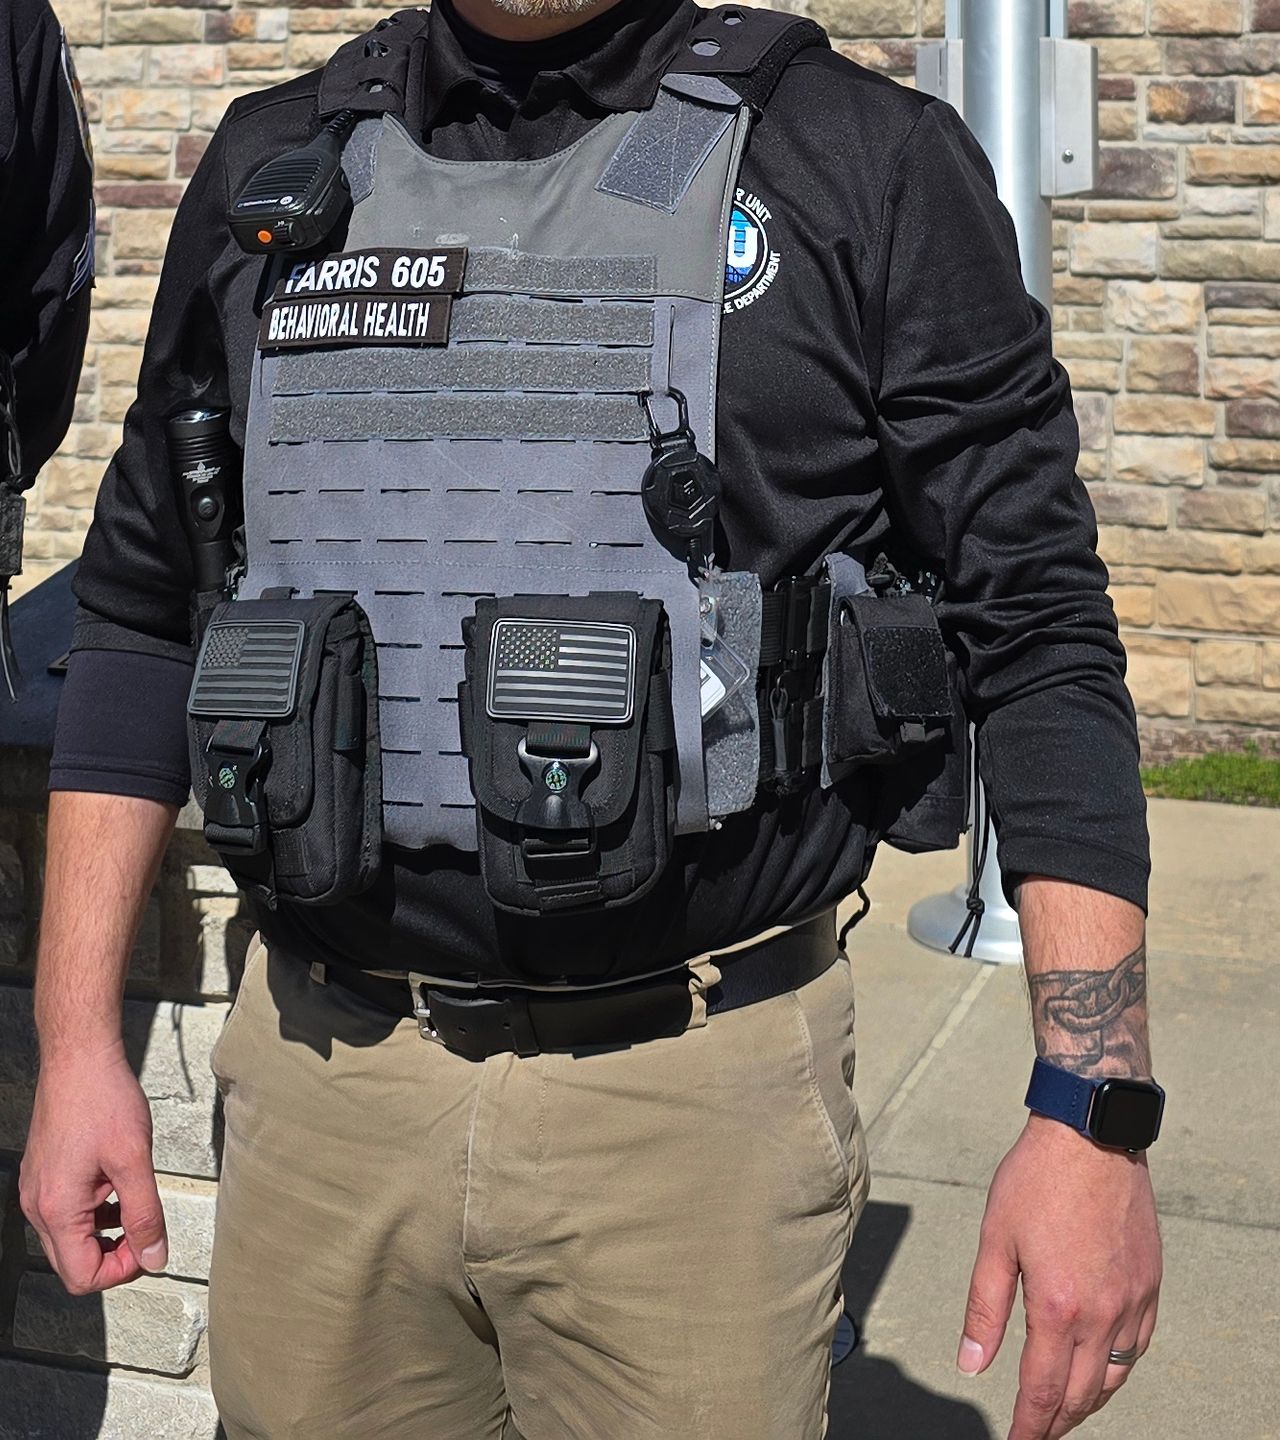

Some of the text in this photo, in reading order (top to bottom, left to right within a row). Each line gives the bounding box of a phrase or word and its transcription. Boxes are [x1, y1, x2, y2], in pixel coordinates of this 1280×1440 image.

[744, 193, 773, 223] UNIT
[390, 255, 448, 289] 605
[733, 250, 781, 310] DEPARTMENT
[267, 301, 431, 341] BEHAVIORAL HEALTH
